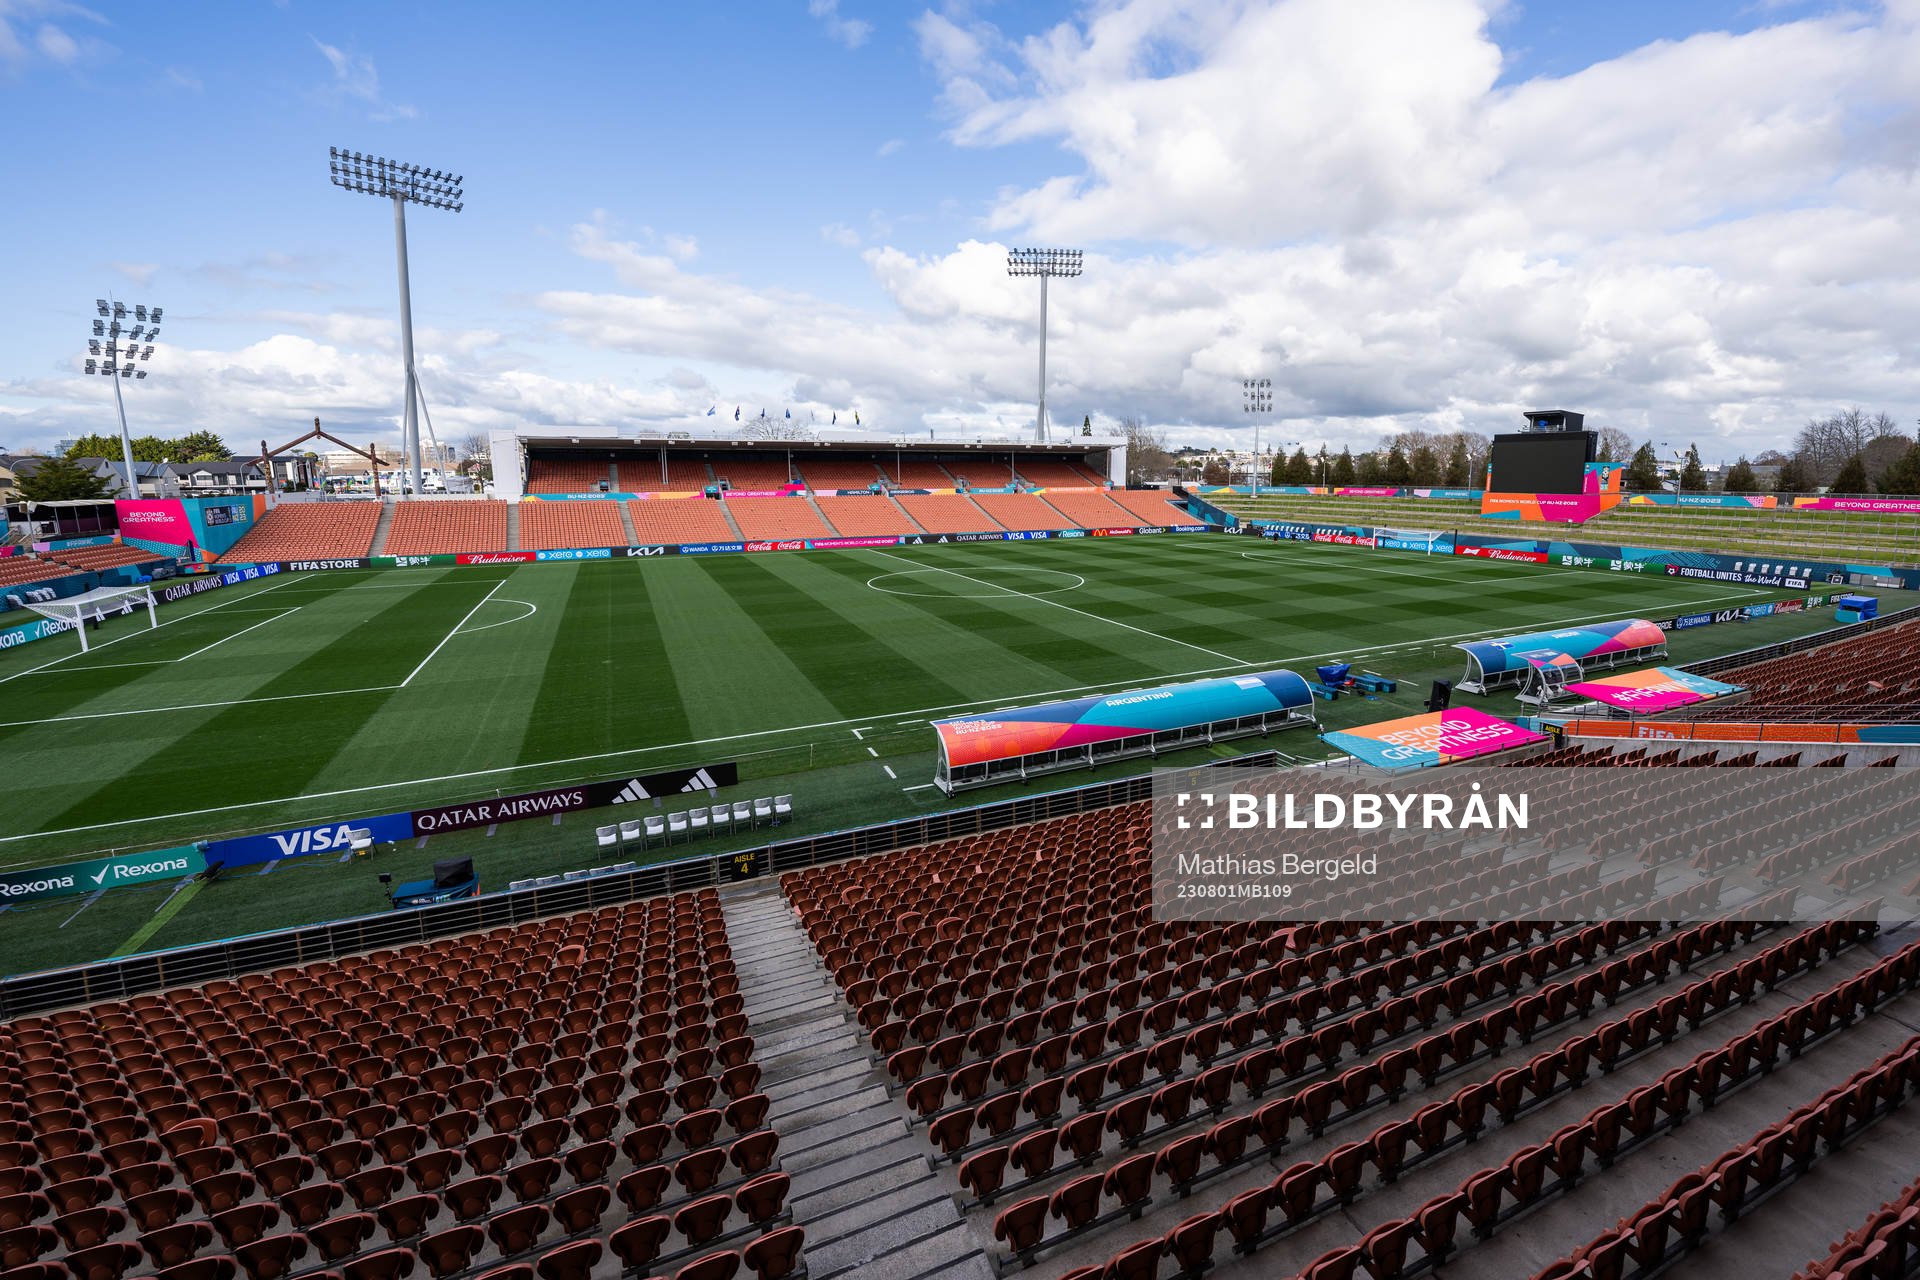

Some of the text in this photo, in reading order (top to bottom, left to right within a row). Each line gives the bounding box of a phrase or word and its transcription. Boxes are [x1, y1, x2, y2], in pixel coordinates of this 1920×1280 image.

[550, 549, 609, 559] xero xero
[627, 546, 664, 556] KIA
[1436, 544, 1454, 553] xero
[468, 554, 526, 564] Budweiser
[1488, 550, 1537, 562] Budweiser
[290, 560, 360, 570] FIFA STORE
[224, 563, 278, 584] VISA VISA VISA
[1681, 567, 1781, 586] FOOTBALL UNITES the World
[166, 576, 222, 600] QATAR AIRWAYS
[1752, 604, 1766, 616] xero
[41, 617, 79, 636] Rexona
[1106, 691, 1174, 707] ARGENTINA
[1377, 720, 1472, 745] BEYOND
[1545, 724, 1560, 734] AISLE
[1639, 726, 1674, 739] FIFA
[1381, 724, 1514, 760] GREATNESS
[418, 792, 583, 830] QATAR AIRWAYS
[268, 825, 353, 855] VISA
[734, 853, 755, 863] AISLE
[740, 863, 749, 873] 4
[0, 857, 187, 896] Rexona Rexona
